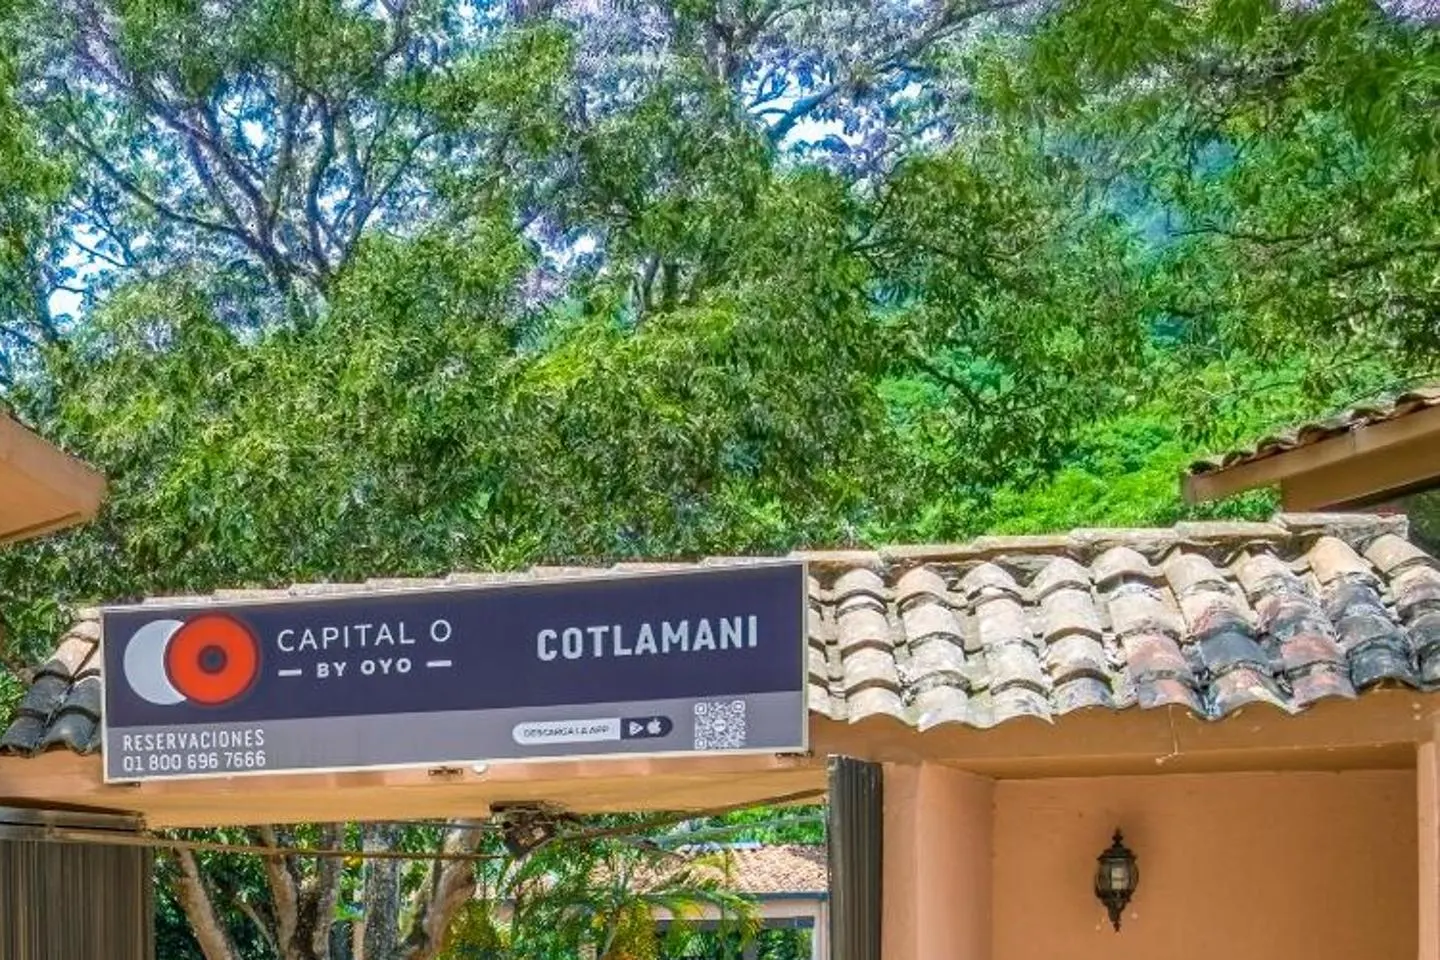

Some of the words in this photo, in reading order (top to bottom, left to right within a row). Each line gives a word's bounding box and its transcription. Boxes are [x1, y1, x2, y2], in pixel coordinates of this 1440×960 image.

[277, 621, 416, 652] CAPITAL
[430, 619, 452, 643] O
[536, 615, 758, 661] COTLAMANI
[316, 661, 347, 678] BY
[360, 657, 411, 675] OYO
[122, 729, 265, 752] RESERVACIONES
[123, 755, 144, 772] 01
[149, 754, 182, 771] 800
[187, 752, 219, 770] 696
[224, 750, 266, 769] 7666
